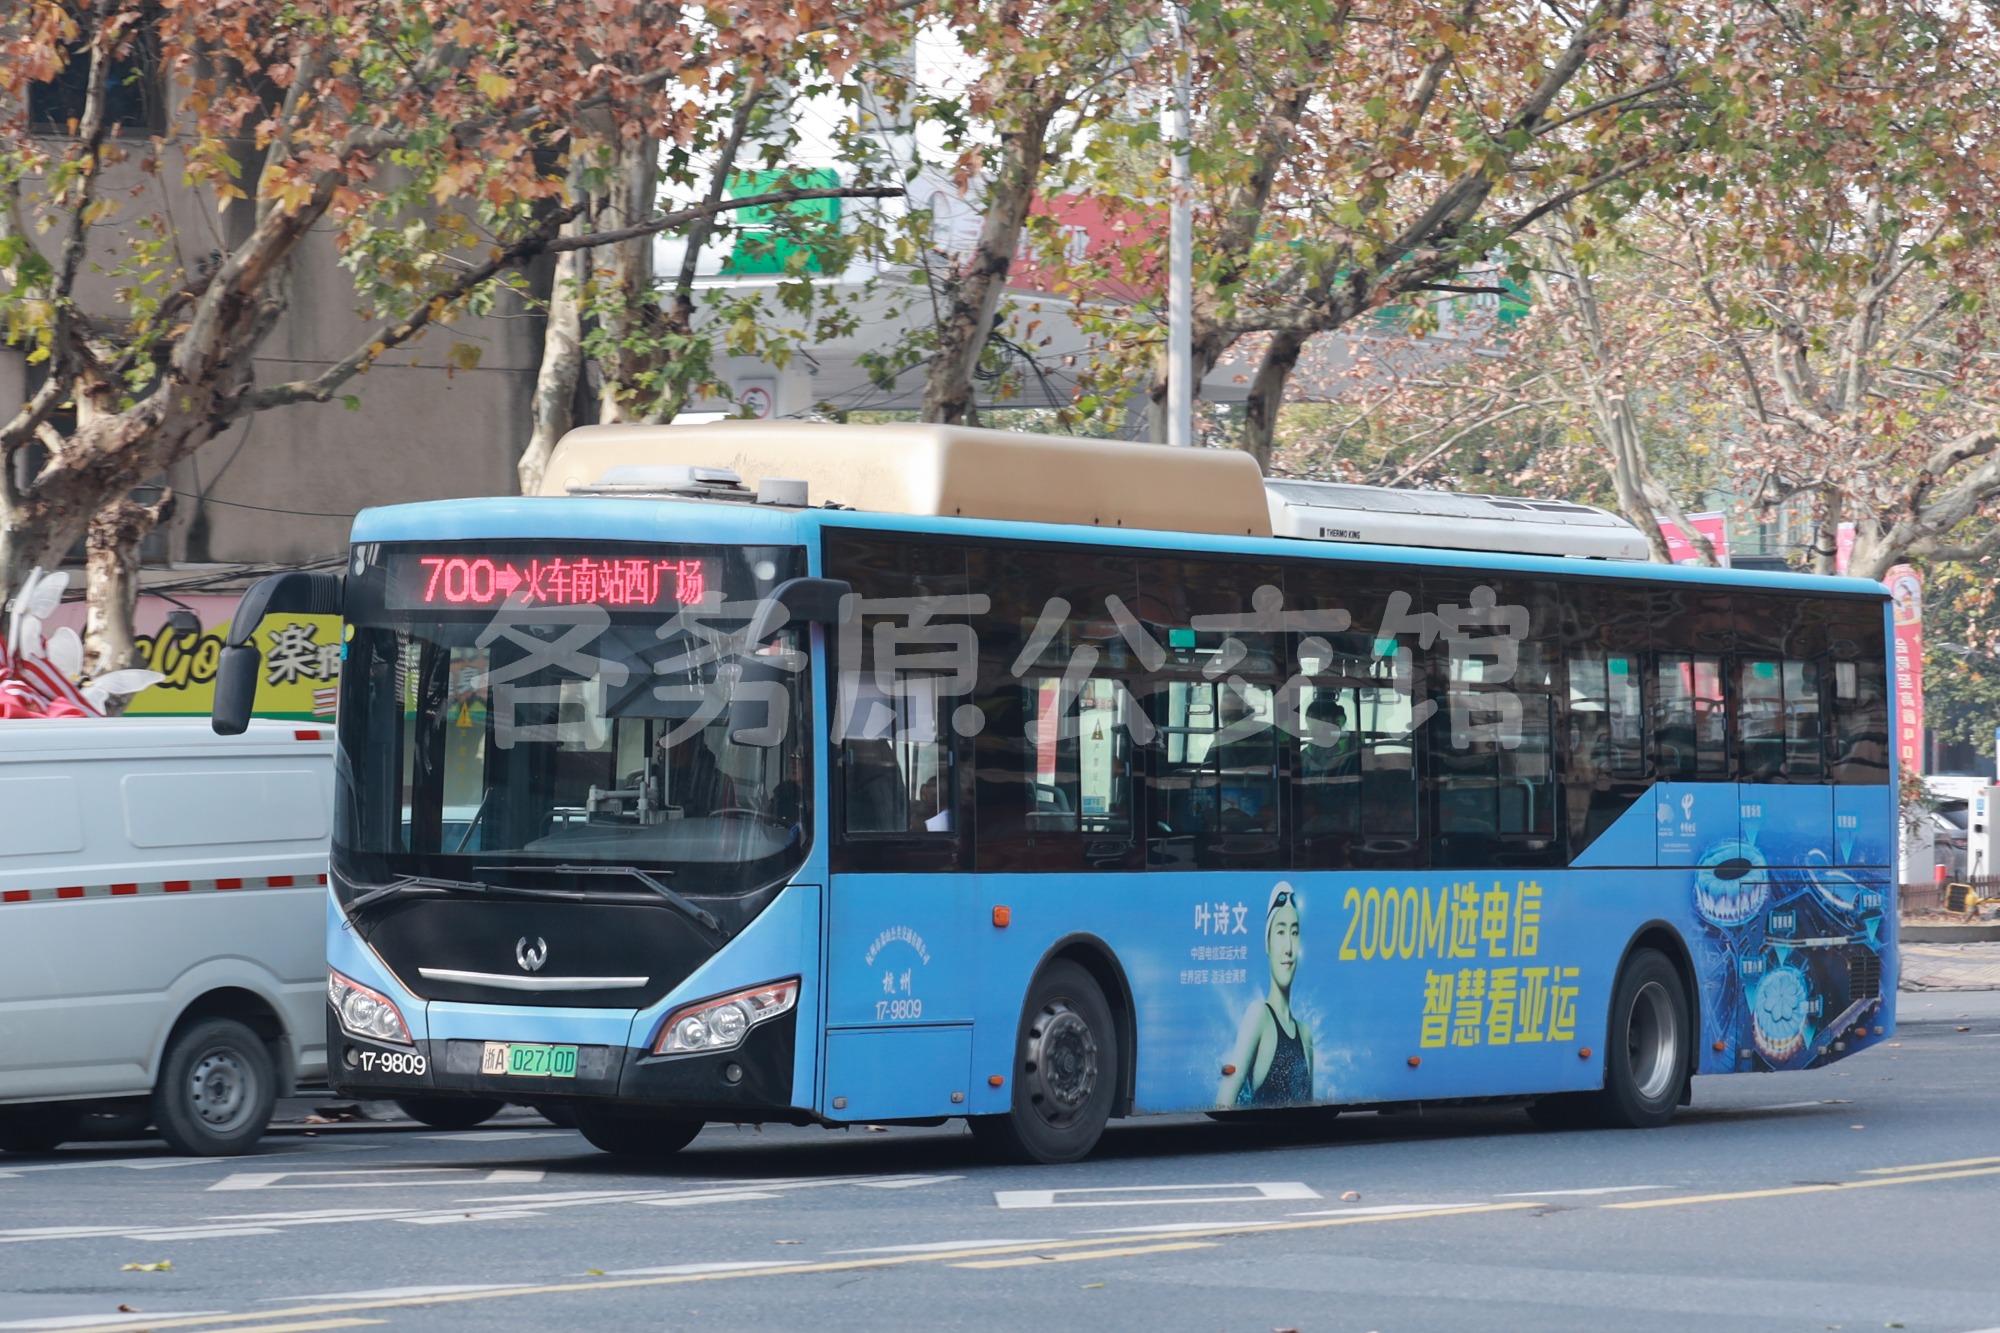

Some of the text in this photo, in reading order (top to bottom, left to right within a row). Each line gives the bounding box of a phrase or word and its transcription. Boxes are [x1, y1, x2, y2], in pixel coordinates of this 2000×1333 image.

[1326, 528, 1361, 540] THERMO KING
[420, 557, 705, 605] 700 火车南站西广场
[1194, 901, 1248, 936] 叶诗文
[1339, 881, 1543, 961] 2000M选电信
[882, 967, 912, 996] 杭州
[875, 998, 922, 1020] 17-9809
[1420, 966, 1580, 1049] 智慧看亚运
[359, 1051, 427, 1076] 17-9809
